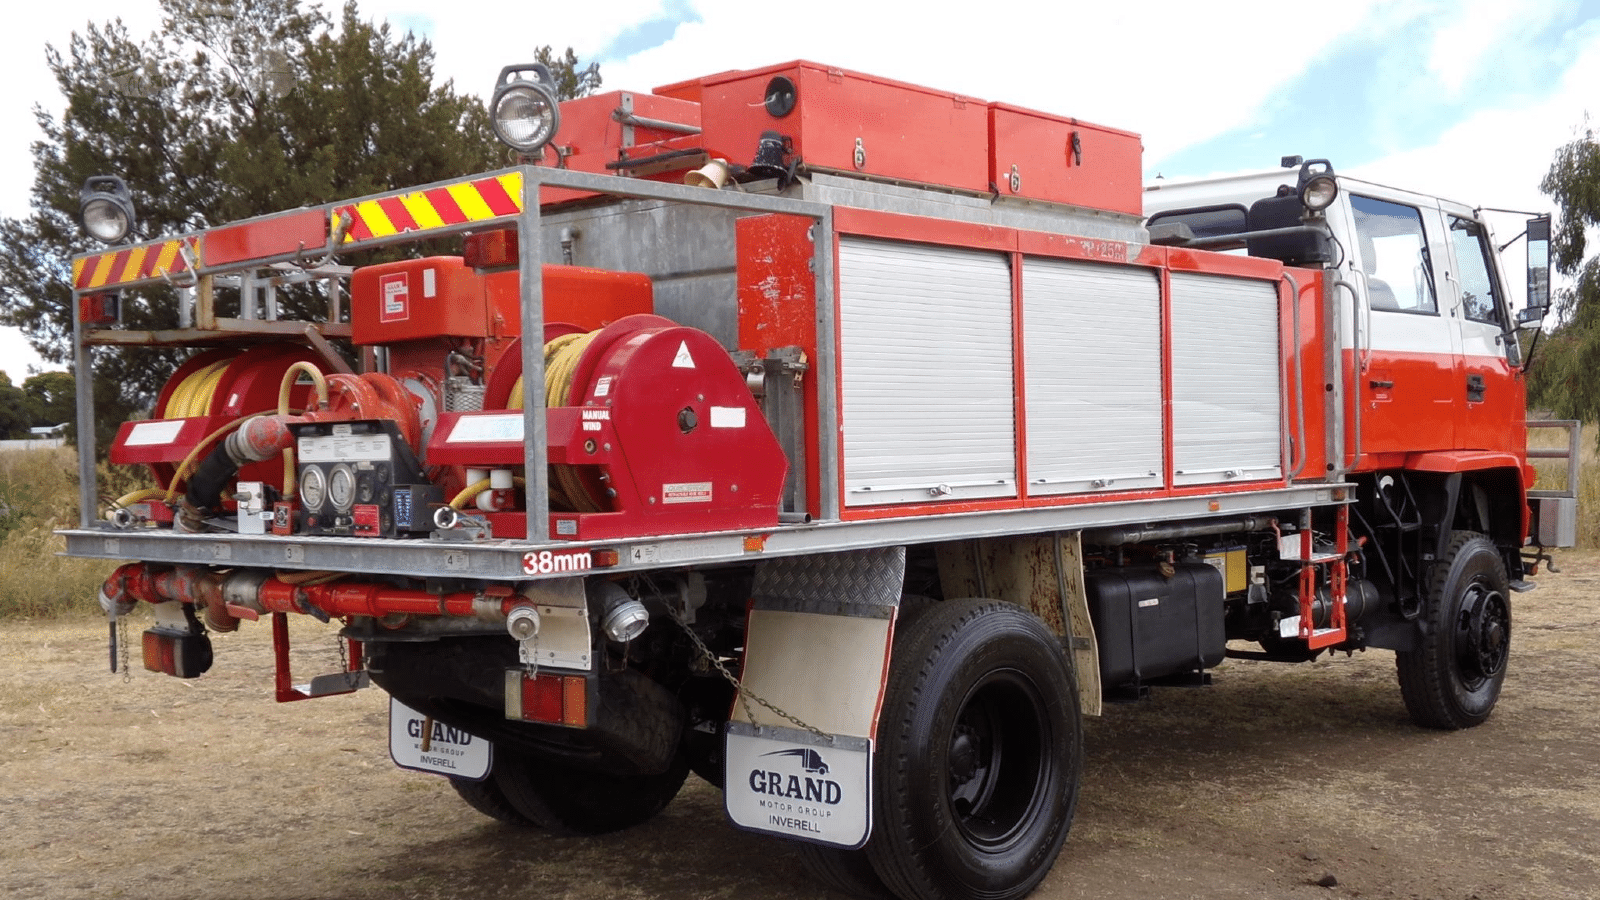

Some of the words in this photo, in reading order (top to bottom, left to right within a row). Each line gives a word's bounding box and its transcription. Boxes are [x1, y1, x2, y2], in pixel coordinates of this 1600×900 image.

[582, 410, 611, 420] MANUAL
[582, 421, 602, 431] WIND
[287, 548, 293, 559] 3
[634, 548, 642, 560] 4
[447, 555, 454, 566] 4
[523, 550, 592, 575] 38mm
[440, 747, 465, 756] GROUP
[420, 755, 456, 769] INVERELL
[749, 769, 842, 805] GRAND
[759, 800, 793, 812] MOTOR
[798, 806, 832, 818] GROUP
[769, 815, 821, 833] INVERELL
